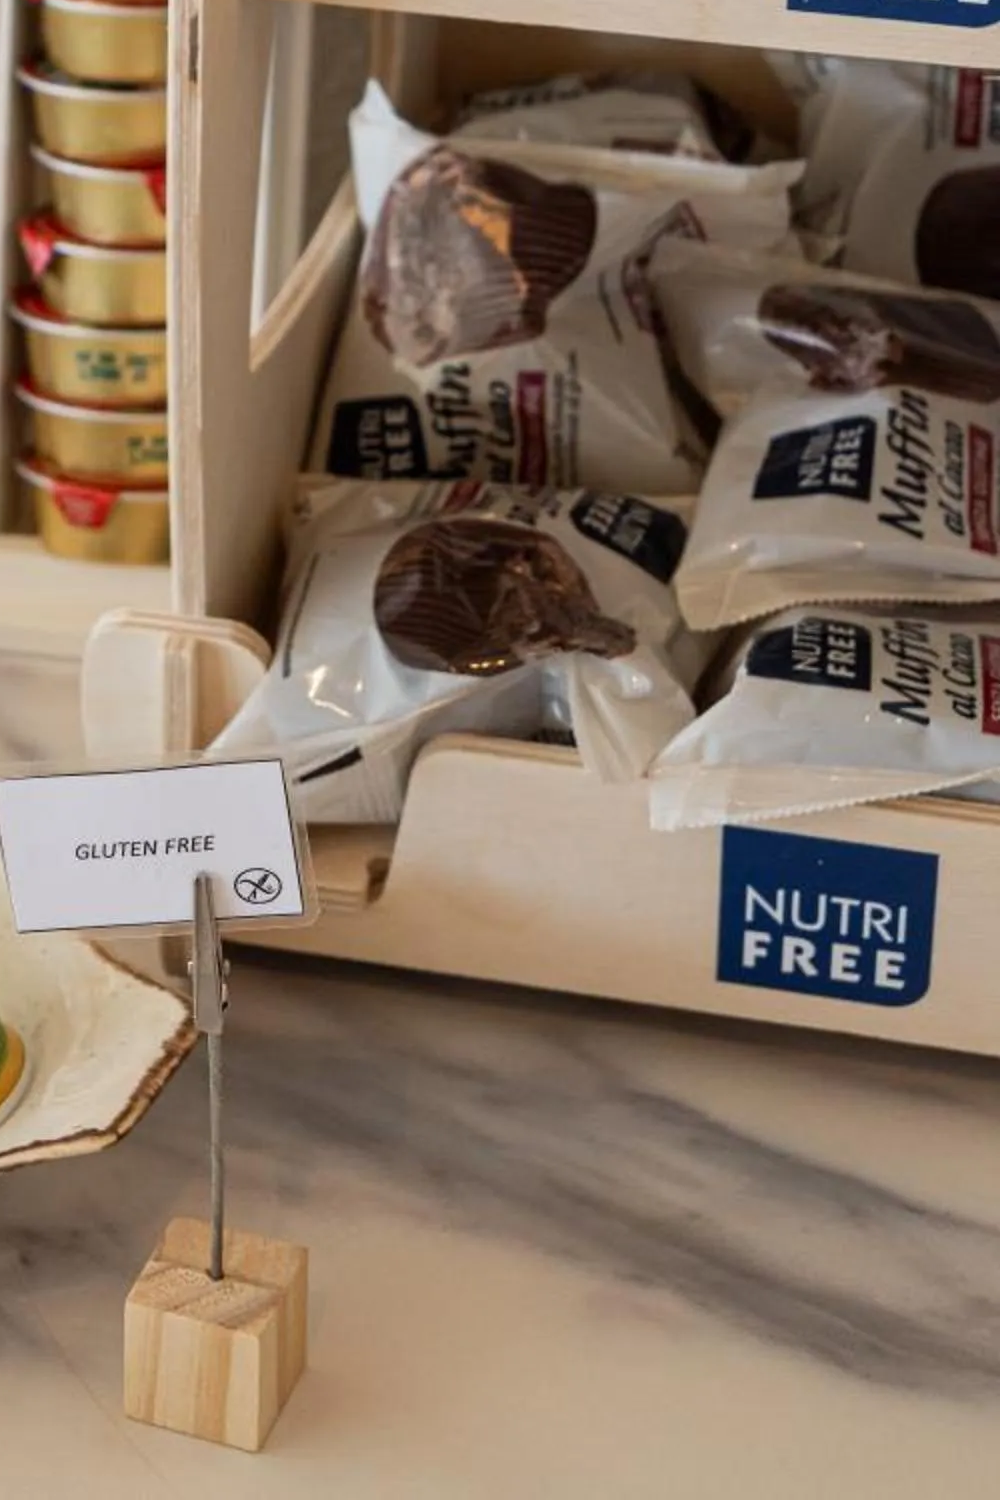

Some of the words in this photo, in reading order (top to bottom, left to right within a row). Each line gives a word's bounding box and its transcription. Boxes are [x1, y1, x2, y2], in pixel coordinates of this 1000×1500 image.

[829, 424, 866, 487] FREE
[878, 389, 936, 540] Muffin
[826, 623, 858, 679] FREE
[880, 619, 941, 726] Muffin
[944, 688, 977, 720] al
[75, 839, 158, 861] GLUTEN
[165, 835, 216, 855] FREE
[745, 884, 908, 943] NUTRI
[740, 930, 906, 990] FREE
